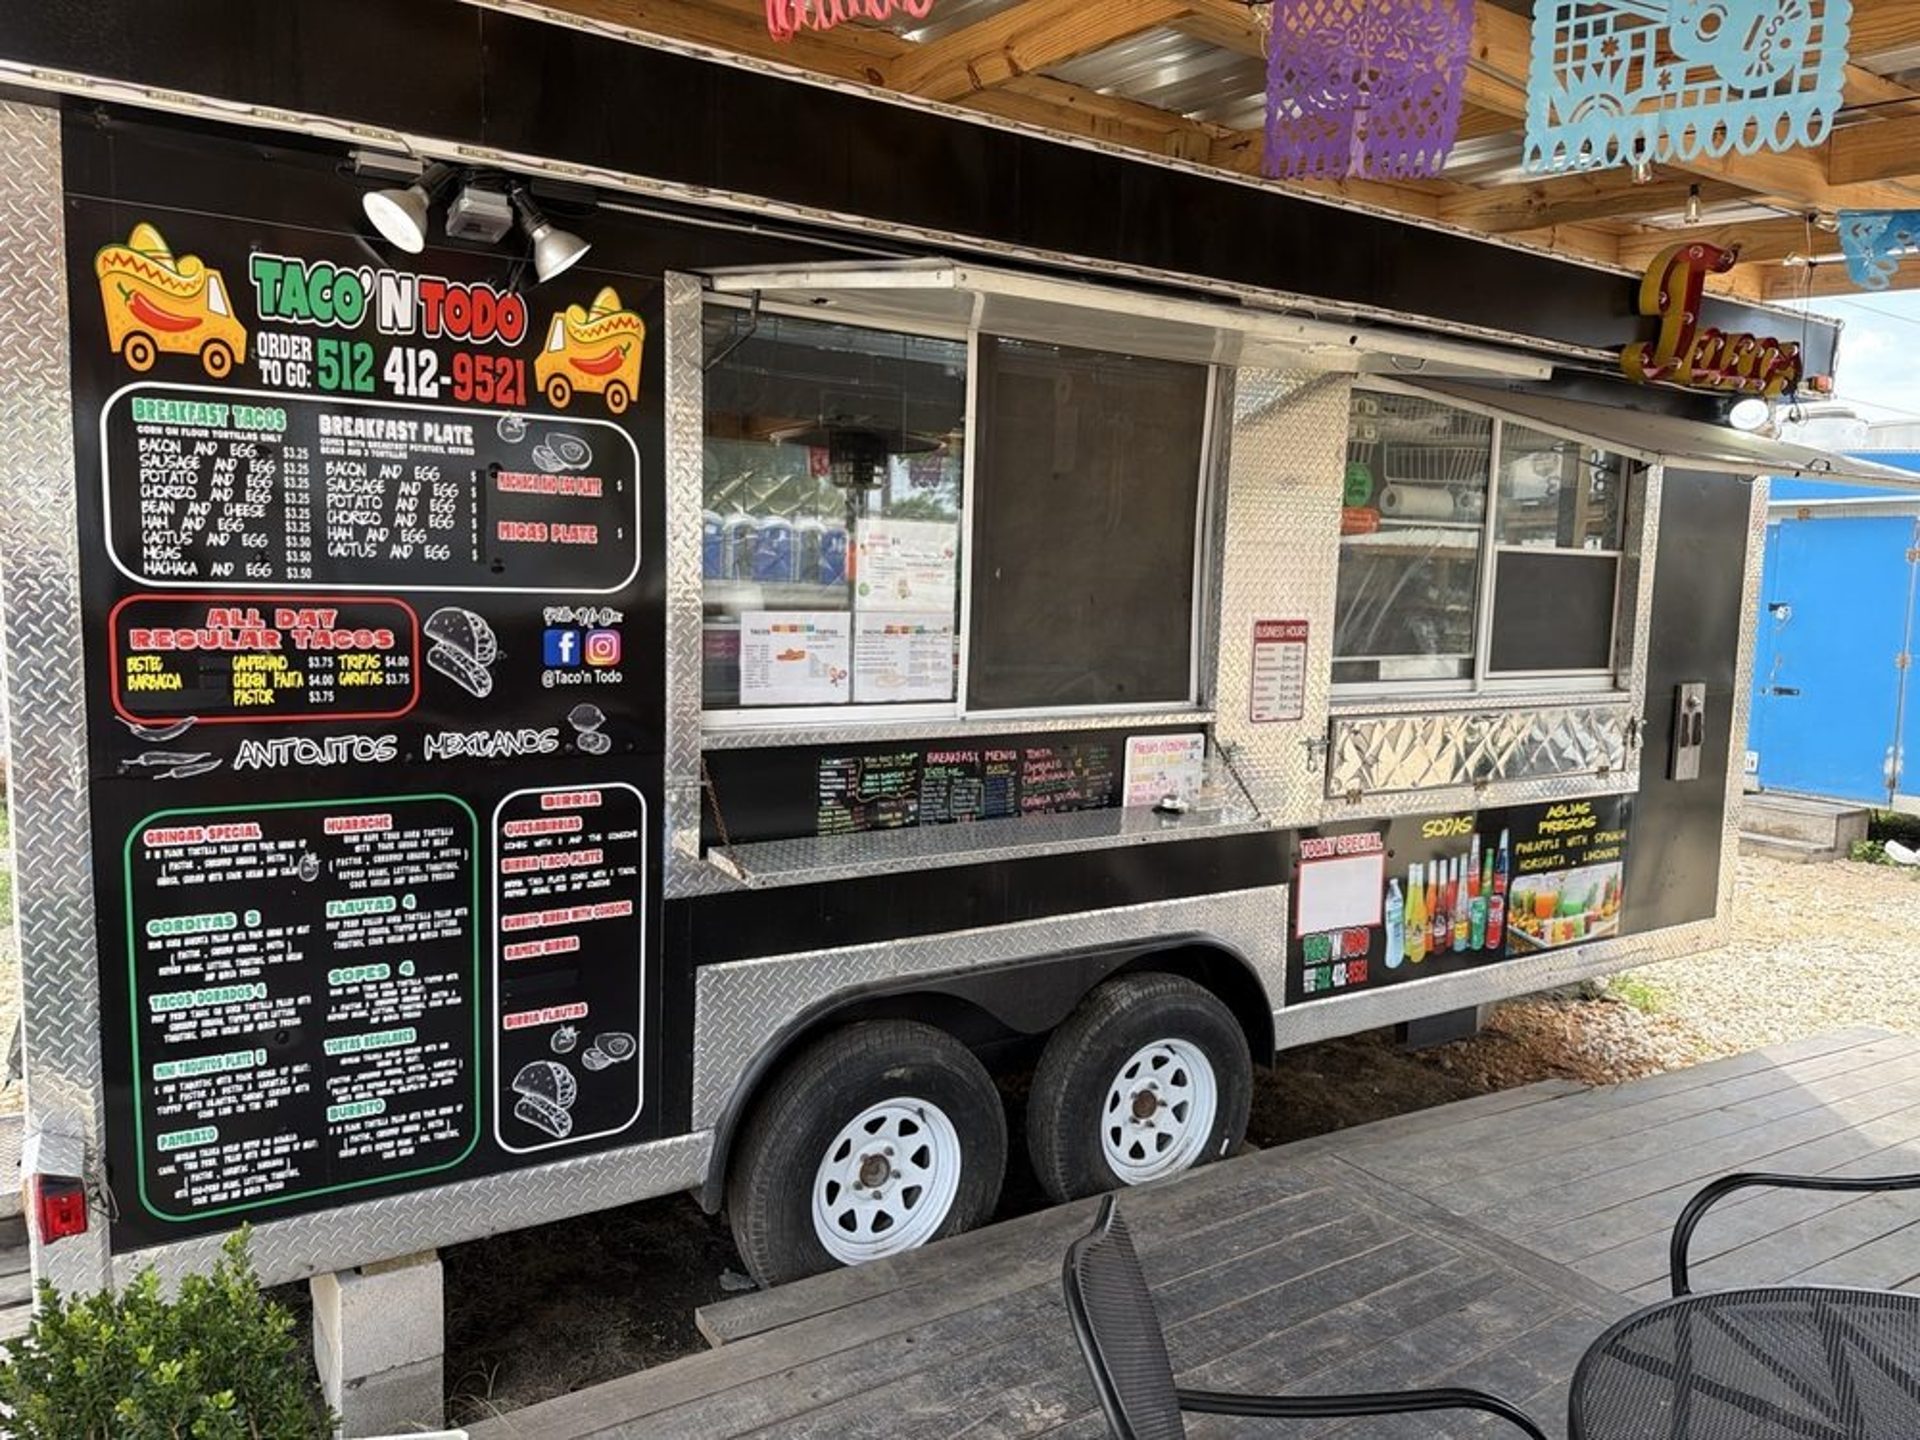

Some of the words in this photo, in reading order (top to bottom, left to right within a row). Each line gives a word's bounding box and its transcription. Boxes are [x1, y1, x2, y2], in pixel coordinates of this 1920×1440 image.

[417, 276, 527, 346] TODO
[257, 332, 312, 361] ORDER
[259, 360, 281, 385] TO
[286, 361, 312, 388] GO:
[317, 339, 375, 393] 512
[383, 347, 527, 406] 412-9521
[132, 398, 229, 428] BREAKFAST
[231, 405, 287, 432] TACOS
[318, 414, 419, 442] BREAKFAST
[423, 422, 474, 446] PLATE
[138, 438, 181, 453] BACON
[194, 441, 217, 455] AND
[230, 443, 257, 458] EGG
[283, 446, 309, 460] $3.25
[140, 454, 200, 470] SAUSAGE
[214, 458, 238, 472] AND
[250, 460, 276, 475] EGG
[283, 462, 310, 475] $3.25
[326, 461, 367, 476] BACON
[379, 464, 402, 479] AND
[414, 466, 440, 482] EGG
[140, 470, 198, 485] POTATO
[211, 473, 235, 487] AND
[246, 474, 273, 489] EGG
[284, 476, 310, 489] $3.25
[326, 477, 386, 494] SAUSAGE
[398, 482, 422, 496] AND
[433, 483, 459, 499] EGG
[140, 485, 197, 499] CHORIZO
[209, 488, 233, 502] AND
[245, 489, 272, 504] EGG
[284, 491, 310, 504] $3.25
[326, 494, 383, 509] POTATO
[395, 498, 419, 512] AND
[429, 499, 456, 514] EGG
[141, 500, 176, 515] BEAN
[187, 502, 211, 516] AND
[224, 503, 266, 517] CHEESE
[285, 507, 311, 520] $3.25
[141, 515, 169, 529] HAM
[181, 517, 206, 531] AND
[217, 518, 245, 533] EGG
[285, 520, 311, 533] $3.25
[393, 513, 417, 527] AND
[428, 514, 455, 529] EGG
[142, 531, 193, 546] CACTUS
[206, 532, 230, 547] AND
[241, 533, 268, 548] EGG
[285, 535, 312, 548] $3.50
[327, 525, 353, 541] HAM
[366, 527, 389, 542] AND
[401, 528, 427, 544] EGG
[498, 521, 548, 541] MIGAS
[551, 523, 598, 544] PLATE
[143, 545, 182, 560] MIGAS
[286, 550, 312, 563] $3.50
[327, 542, 377, 558] CACTUS
[390, 544, 413, 559] AND
[424, 544, 450, 561] EGG
[143, 561, 198, 576] MACHACA
[210, 562, 234, 577] AND
[245, 563, 272, 577] EGG
[286, 567, 312, 579] $3.50
[206, 608, 266, 629] ALL
[275, 608, 338, 629] DAY
[129, 629, 282, 650] REGULAR
[291, 629, 395, 650] TACOS
[308, 656, 334, 669] $3.75
[338, 654, 382, 670] TRIPAS
[308, 674, 335, 687] $4.00
[385, 673, 410, 685] $3.75
[594, 669, 623, 684] Todo
[233, 689, 275, 706] PASTOR
[308, 690, 335, 703] $3.75
[233, 736, 397, 771] ANTOJITOS
[424, 728, 560, 761] MEXICANOS
[541, 790, 602, 811] BIRRIA
[144, 827, 206, 847] GRINGAS
[206, 822, 263, 842] SPECIAL
[324, 814, 393, 834] HUARACHE
[1422, 816, 1474, 839] SODAS
[1300, 837, 1336, 859] TODAY
[1336, 831, 1383, 855] SPECIAL
[501, 855, 540, 874] BIRRIA
[540, 852, 570, 870] TACO
[569, 848, 604, 866] PLATE
[326, 896, 397, 918] FLAUTAS
[146, 912, 238, 938] GORDITAS
[328, 963, 391, 986] SOPES
[149, 994, 195, 1013] TACOS
[195, 985, 256, 1006] DORADOS
[326, 1098, 387, 1123] BURRITO
